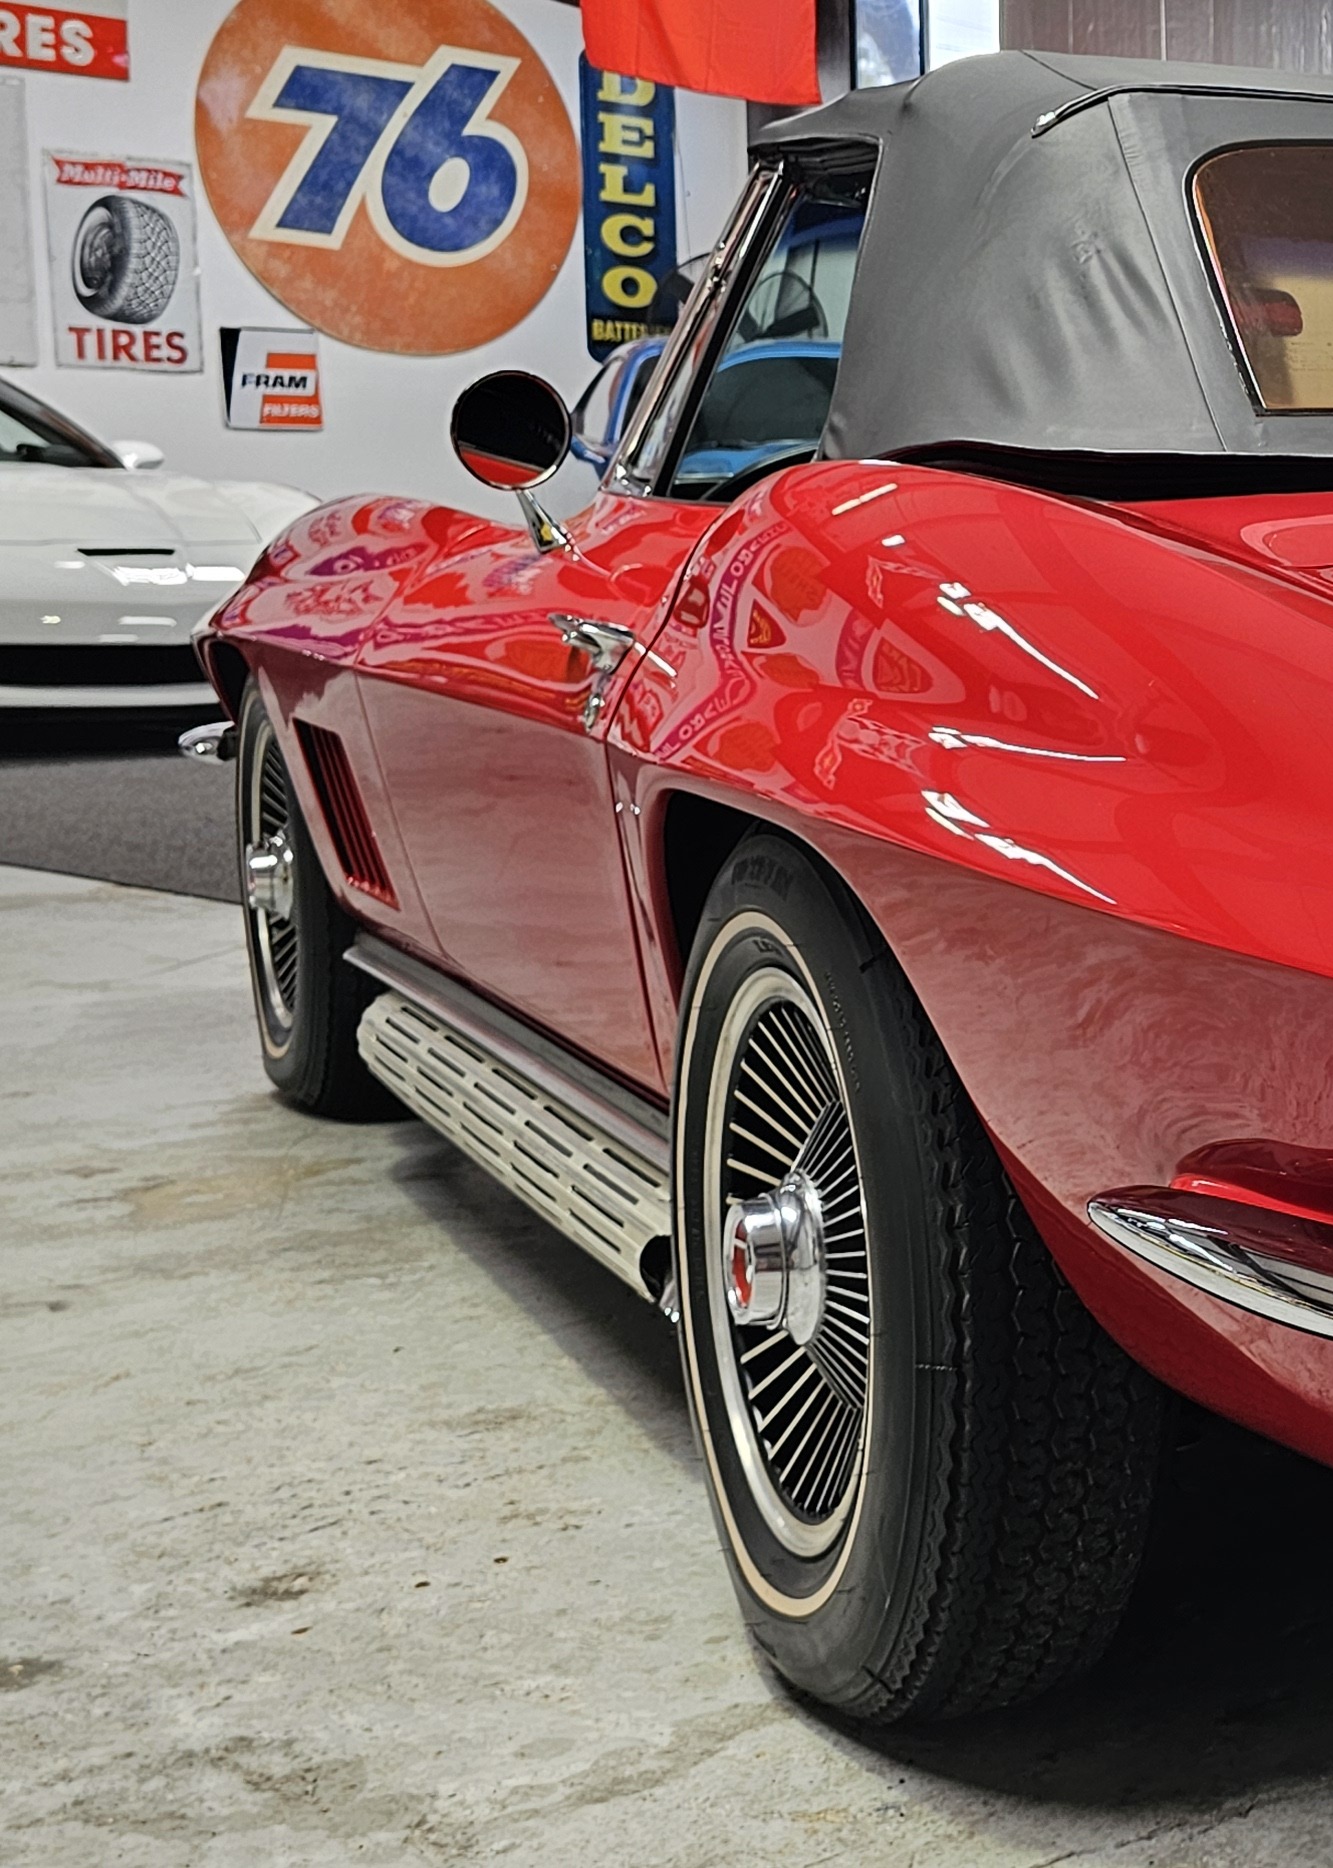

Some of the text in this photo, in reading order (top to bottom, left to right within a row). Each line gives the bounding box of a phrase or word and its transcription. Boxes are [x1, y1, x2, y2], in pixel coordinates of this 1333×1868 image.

[246, 44, 529, 267] 76
[61, 163, 177, 190] Multi-Mile
[597, 71, 658, 309] DELCO
[68, 327, 188, 364] TIRES
[241, 373, 308, 390] FRAM
[262, 403, 320, 418] FILTERS
